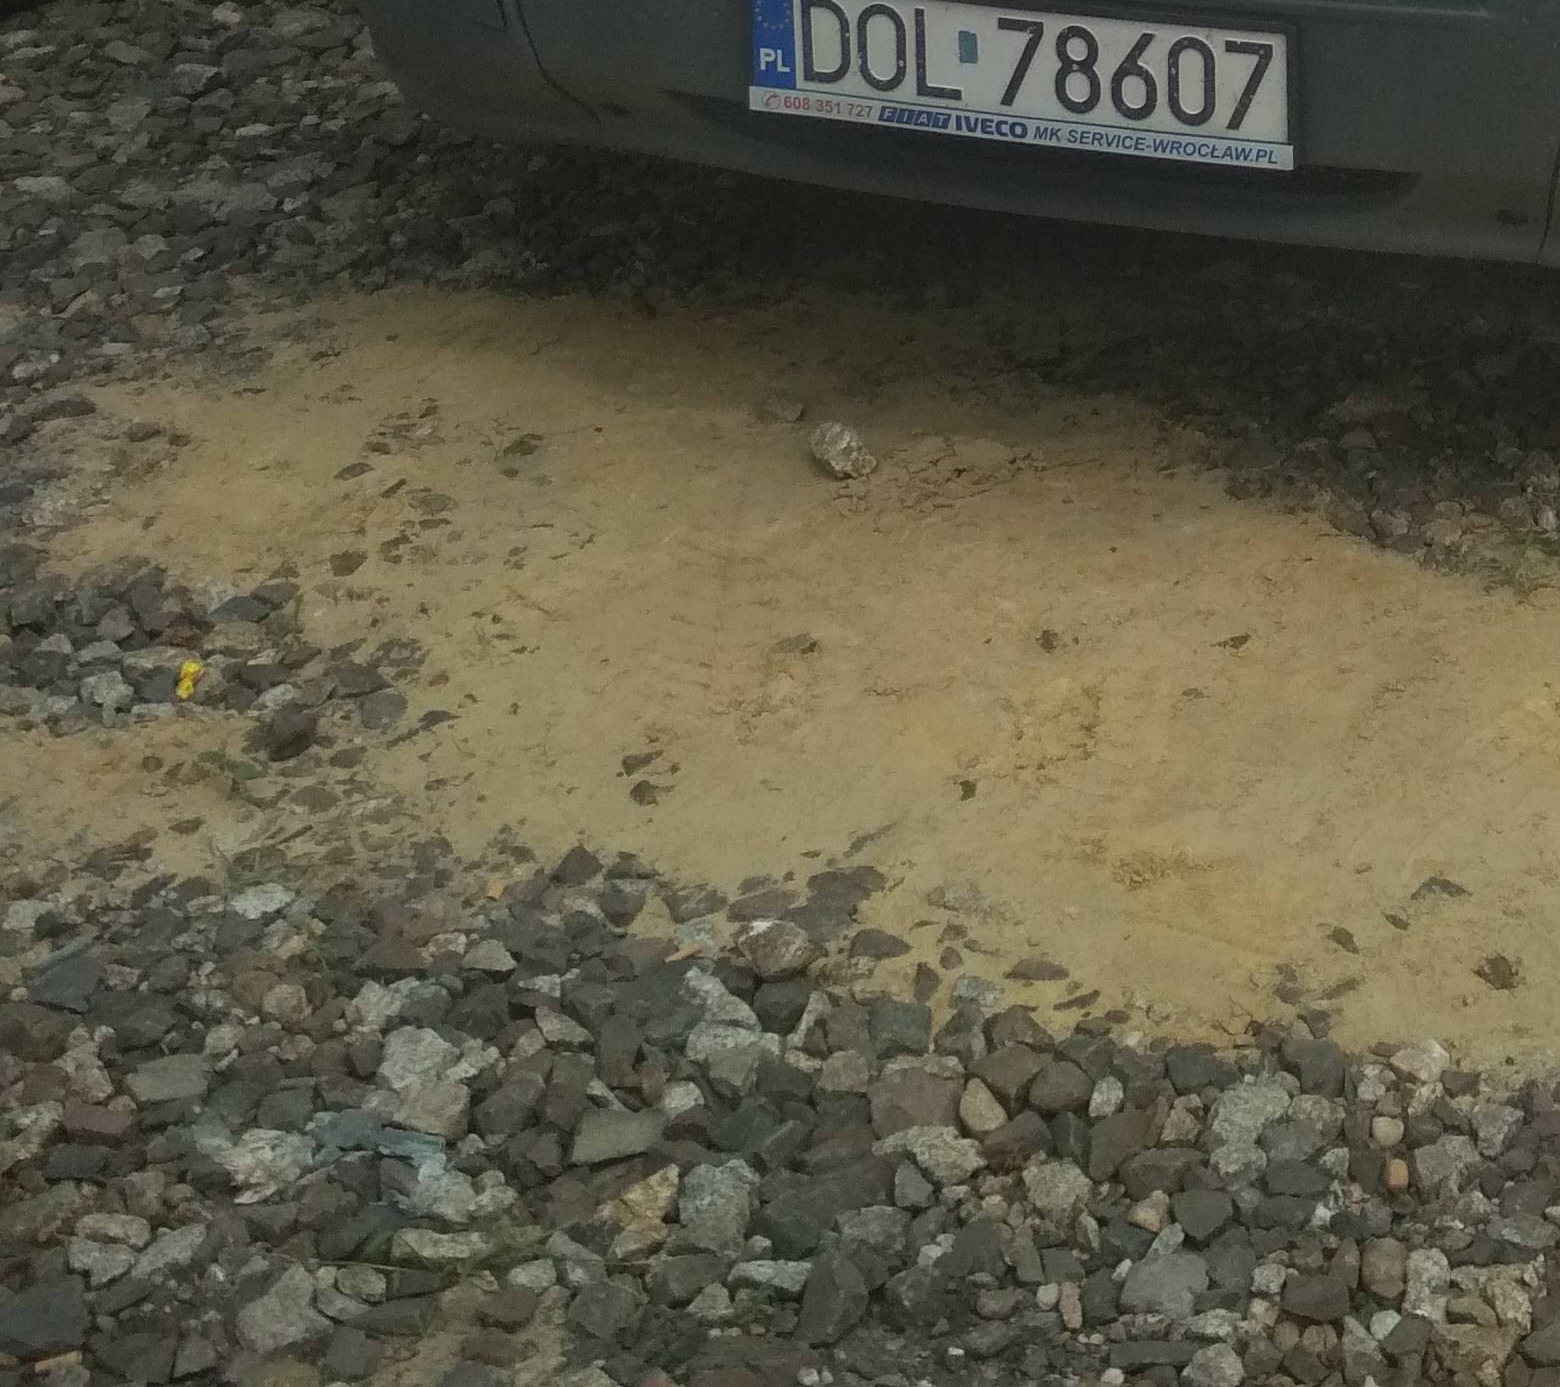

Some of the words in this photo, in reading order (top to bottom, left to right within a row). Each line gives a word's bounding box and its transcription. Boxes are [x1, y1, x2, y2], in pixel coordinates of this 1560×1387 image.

[759, 48, 790, 73] PL
[997, 16, 1275, 130] 78607
[784, 98, 810, 111] 608
[816, 101, 842, 115] 351
[847, 103, 873, 119] 727
[880, 106, 950, 127] FIAT
[955, 114, 1028, 139] IVECO
[1033, 125, 1062, 142] MK
